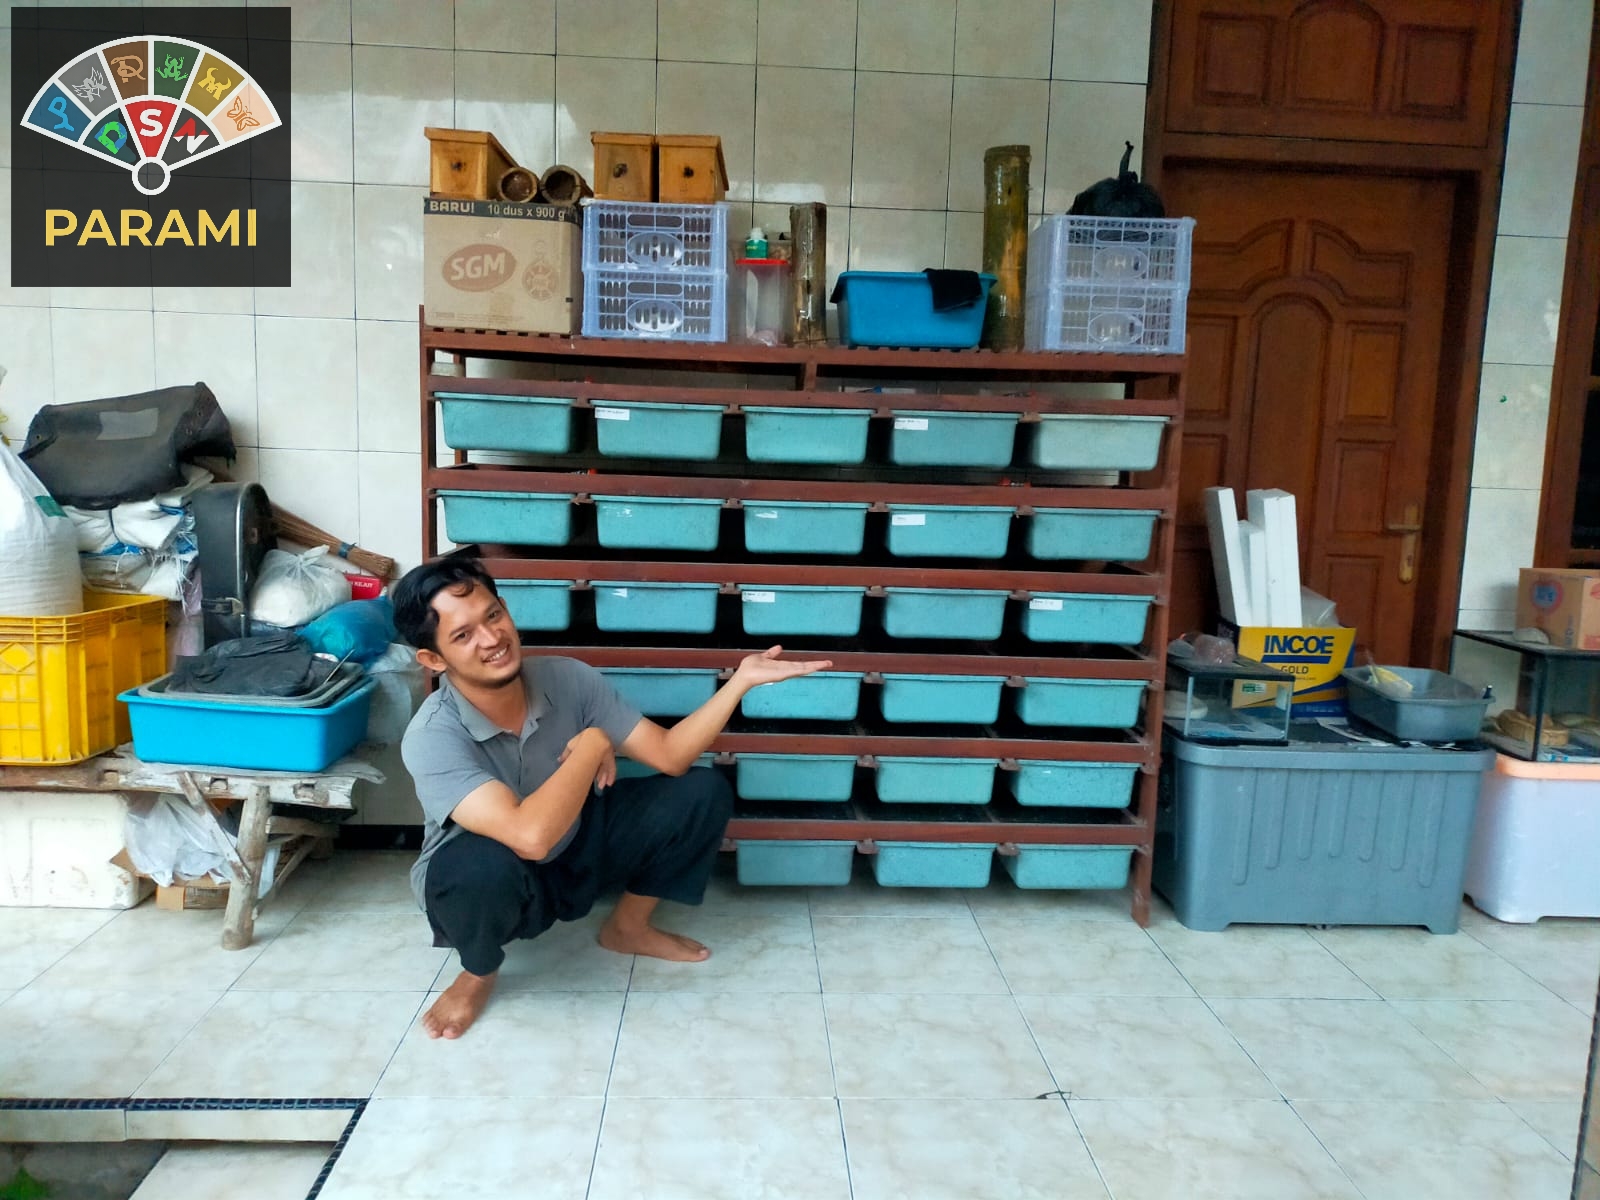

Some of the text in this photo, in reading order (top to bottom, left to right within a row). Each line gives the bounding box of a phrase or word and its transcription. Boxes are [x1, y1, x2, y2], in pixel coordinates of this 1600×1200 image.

[430, 201, 475, 213] BARU!
[488, 204, 565, 221] 10 dus x 900 g
[451, 253, 506, 281] SGM
[1264, 635, 1335, 654] INCOE
[1280, 665, 1309, 674] GOLD
